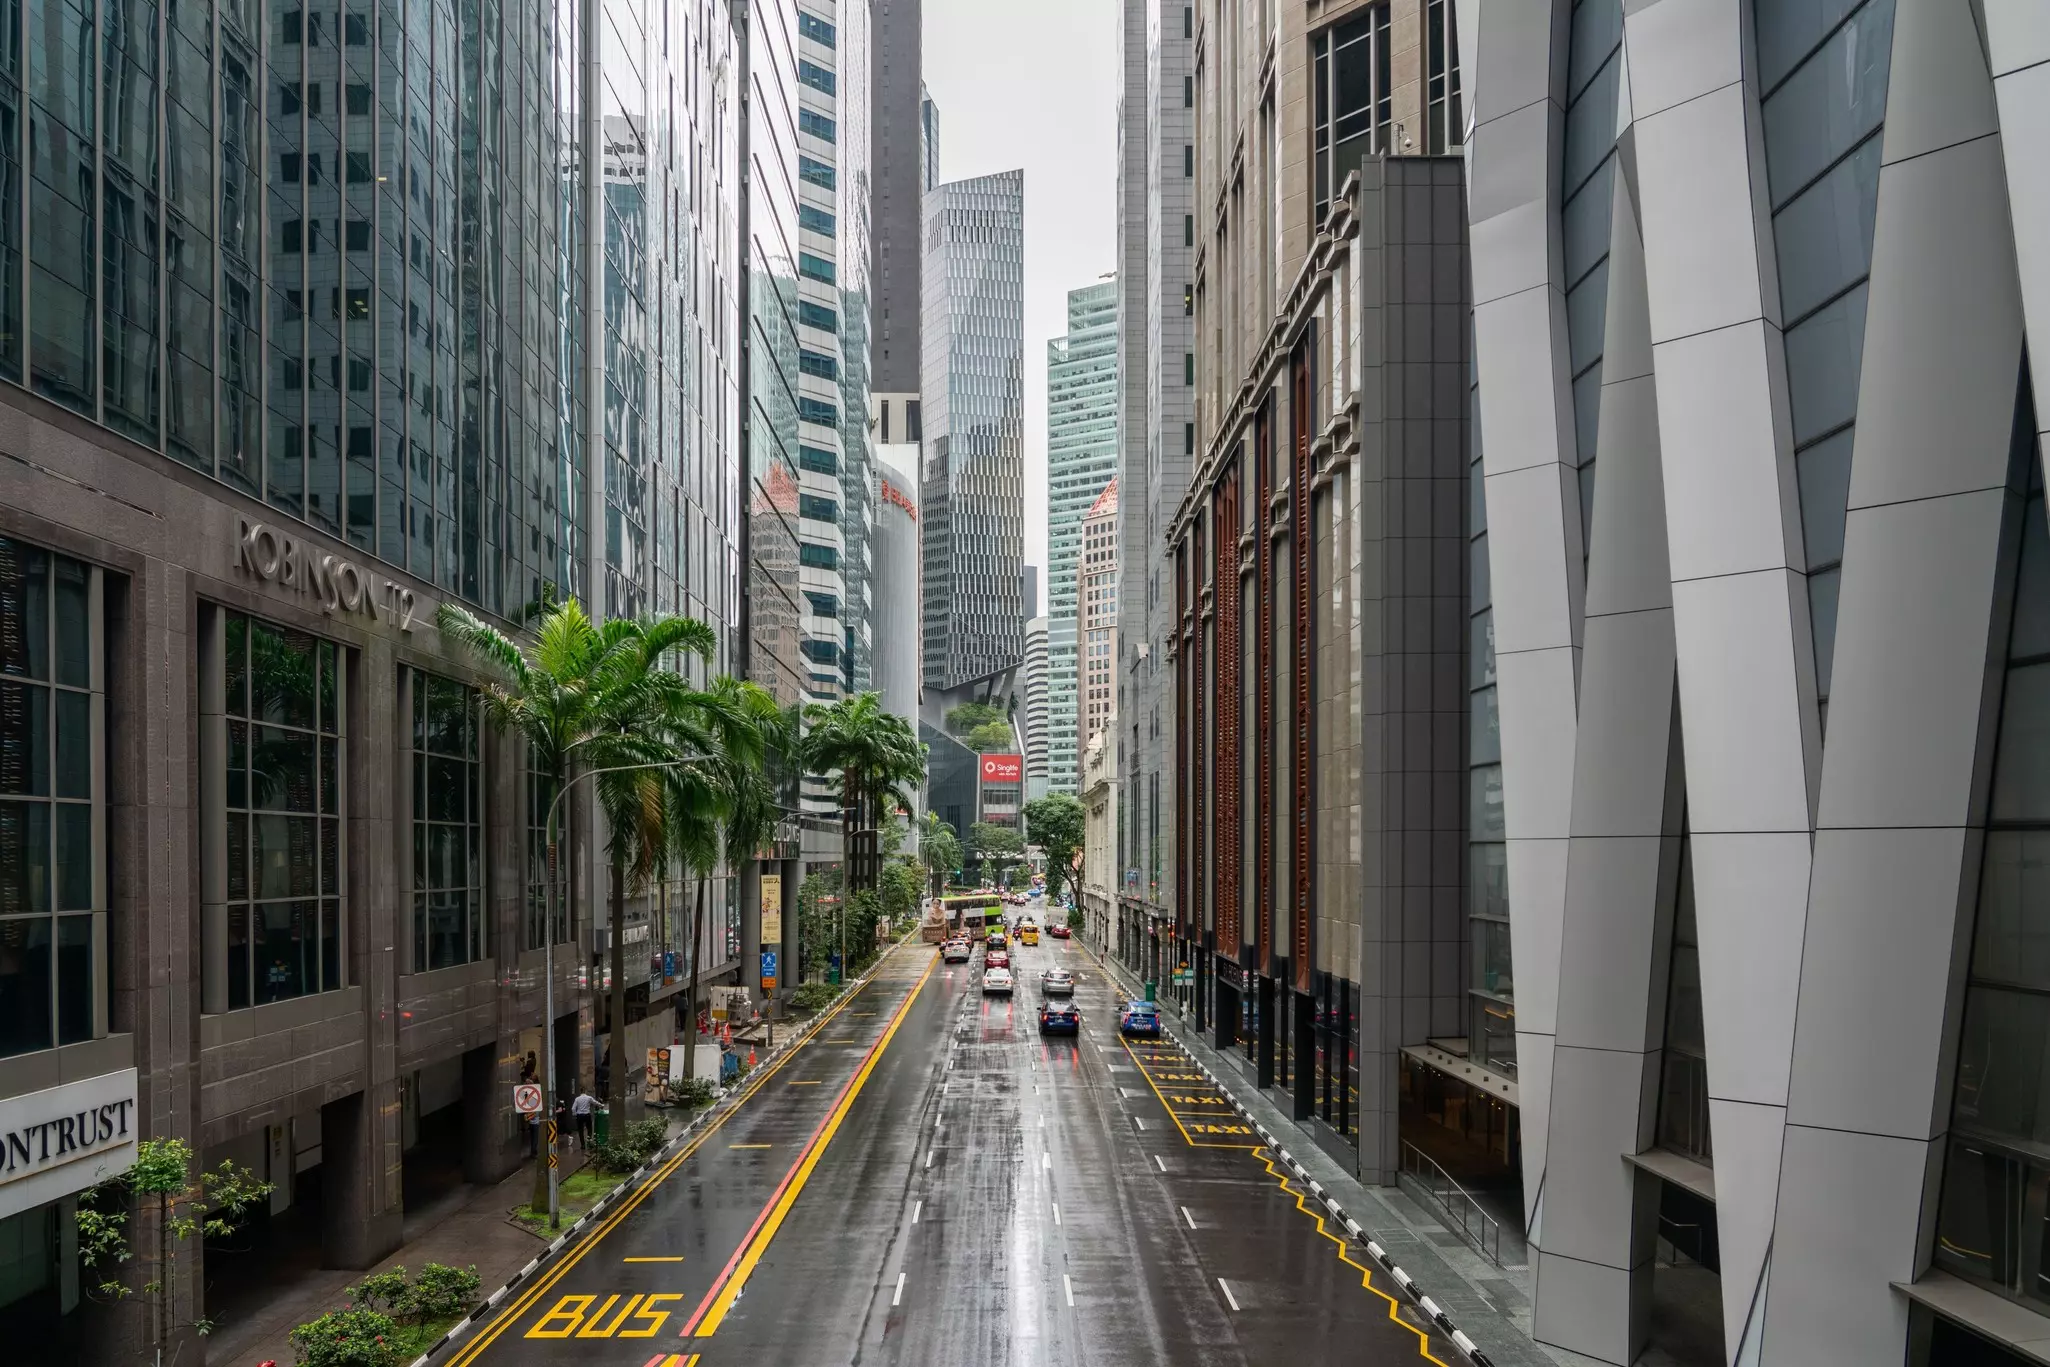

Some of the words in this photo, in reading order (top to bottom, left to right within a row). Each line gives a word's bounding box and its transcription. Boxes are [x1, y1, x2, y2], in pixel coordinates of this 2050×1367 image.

[233, 513, 378, 621] ROBINSON
[1170, 1096, 1225, 1105] TAXI
[0, 1098, 133, 1172] NTRUST
[1190, 1124, 1252, 1135] TAXI
[523, 1293, 684, 1338] BUS
